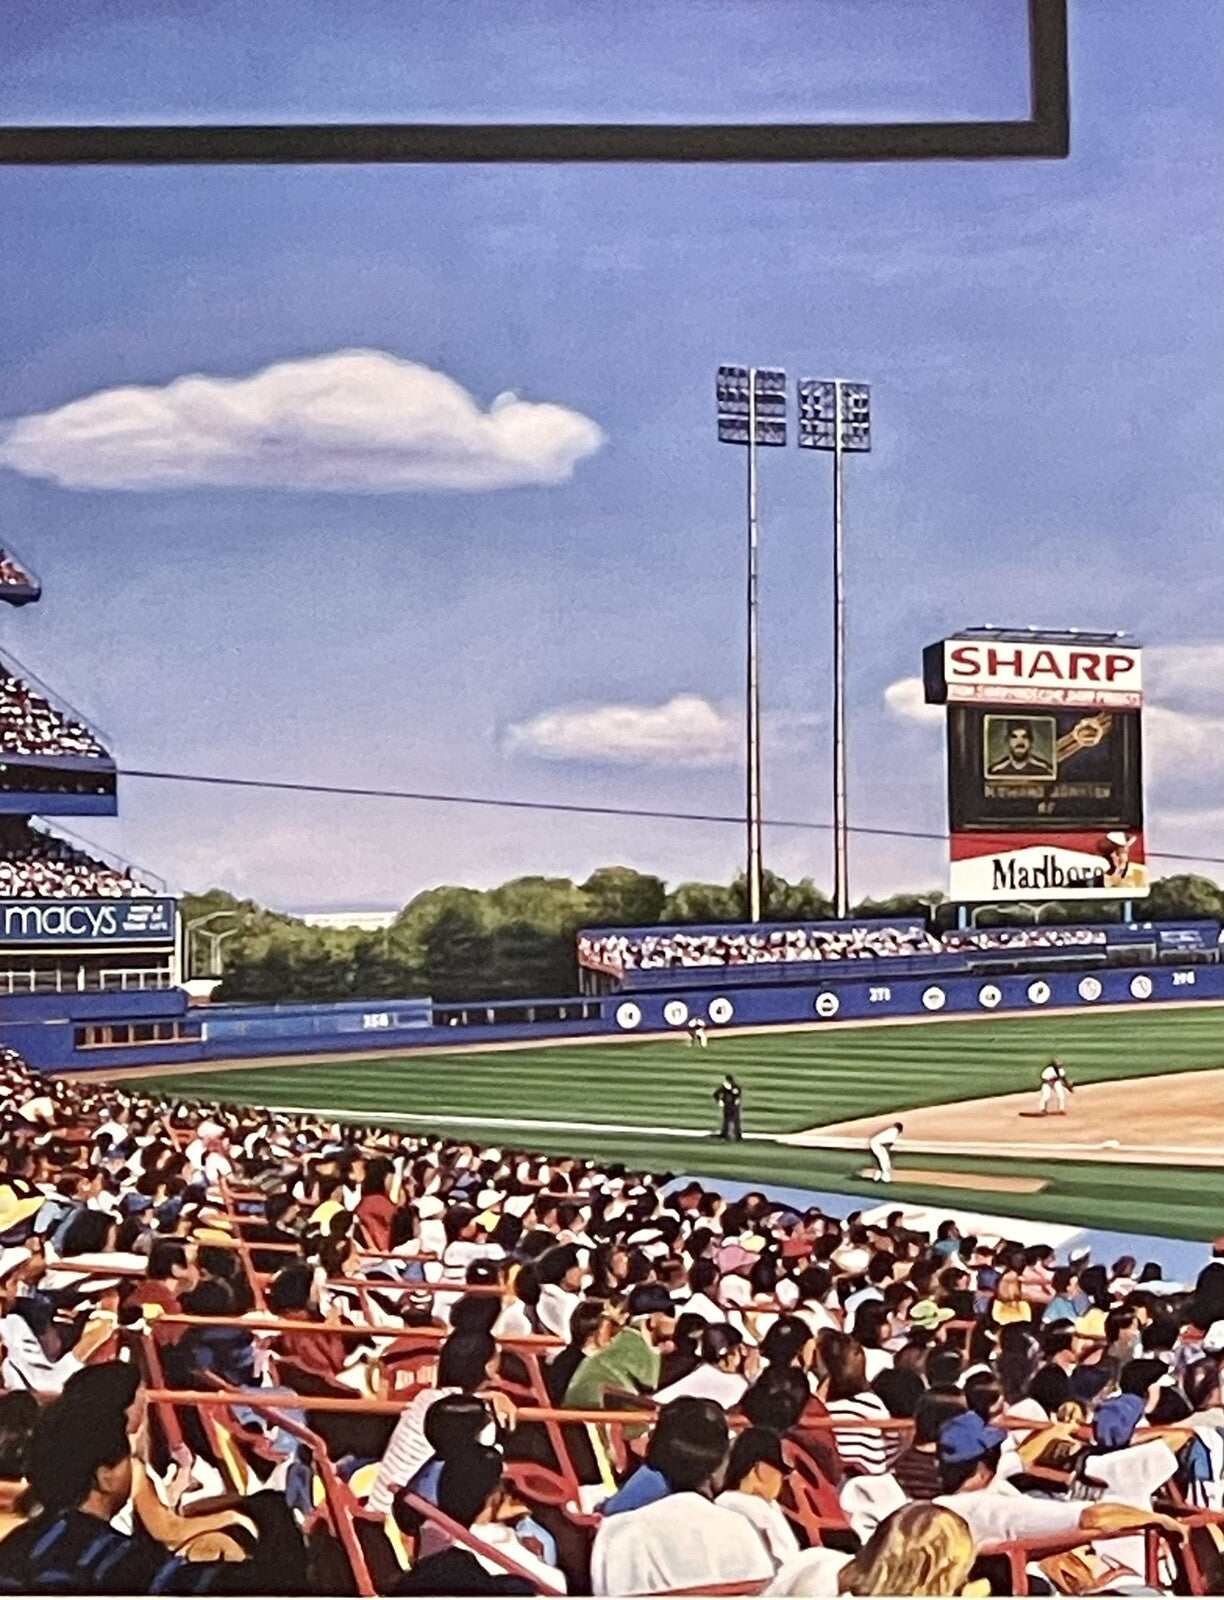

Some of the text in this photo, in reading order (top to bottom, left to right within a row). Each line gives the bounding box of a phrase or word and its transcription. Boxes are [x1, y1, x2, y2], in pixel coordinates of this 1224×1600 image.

[950, 646, 1135, 682] SHARP
[992, 854, 1104, 891] Marlboro
[5, 906, 117, 936] macys
